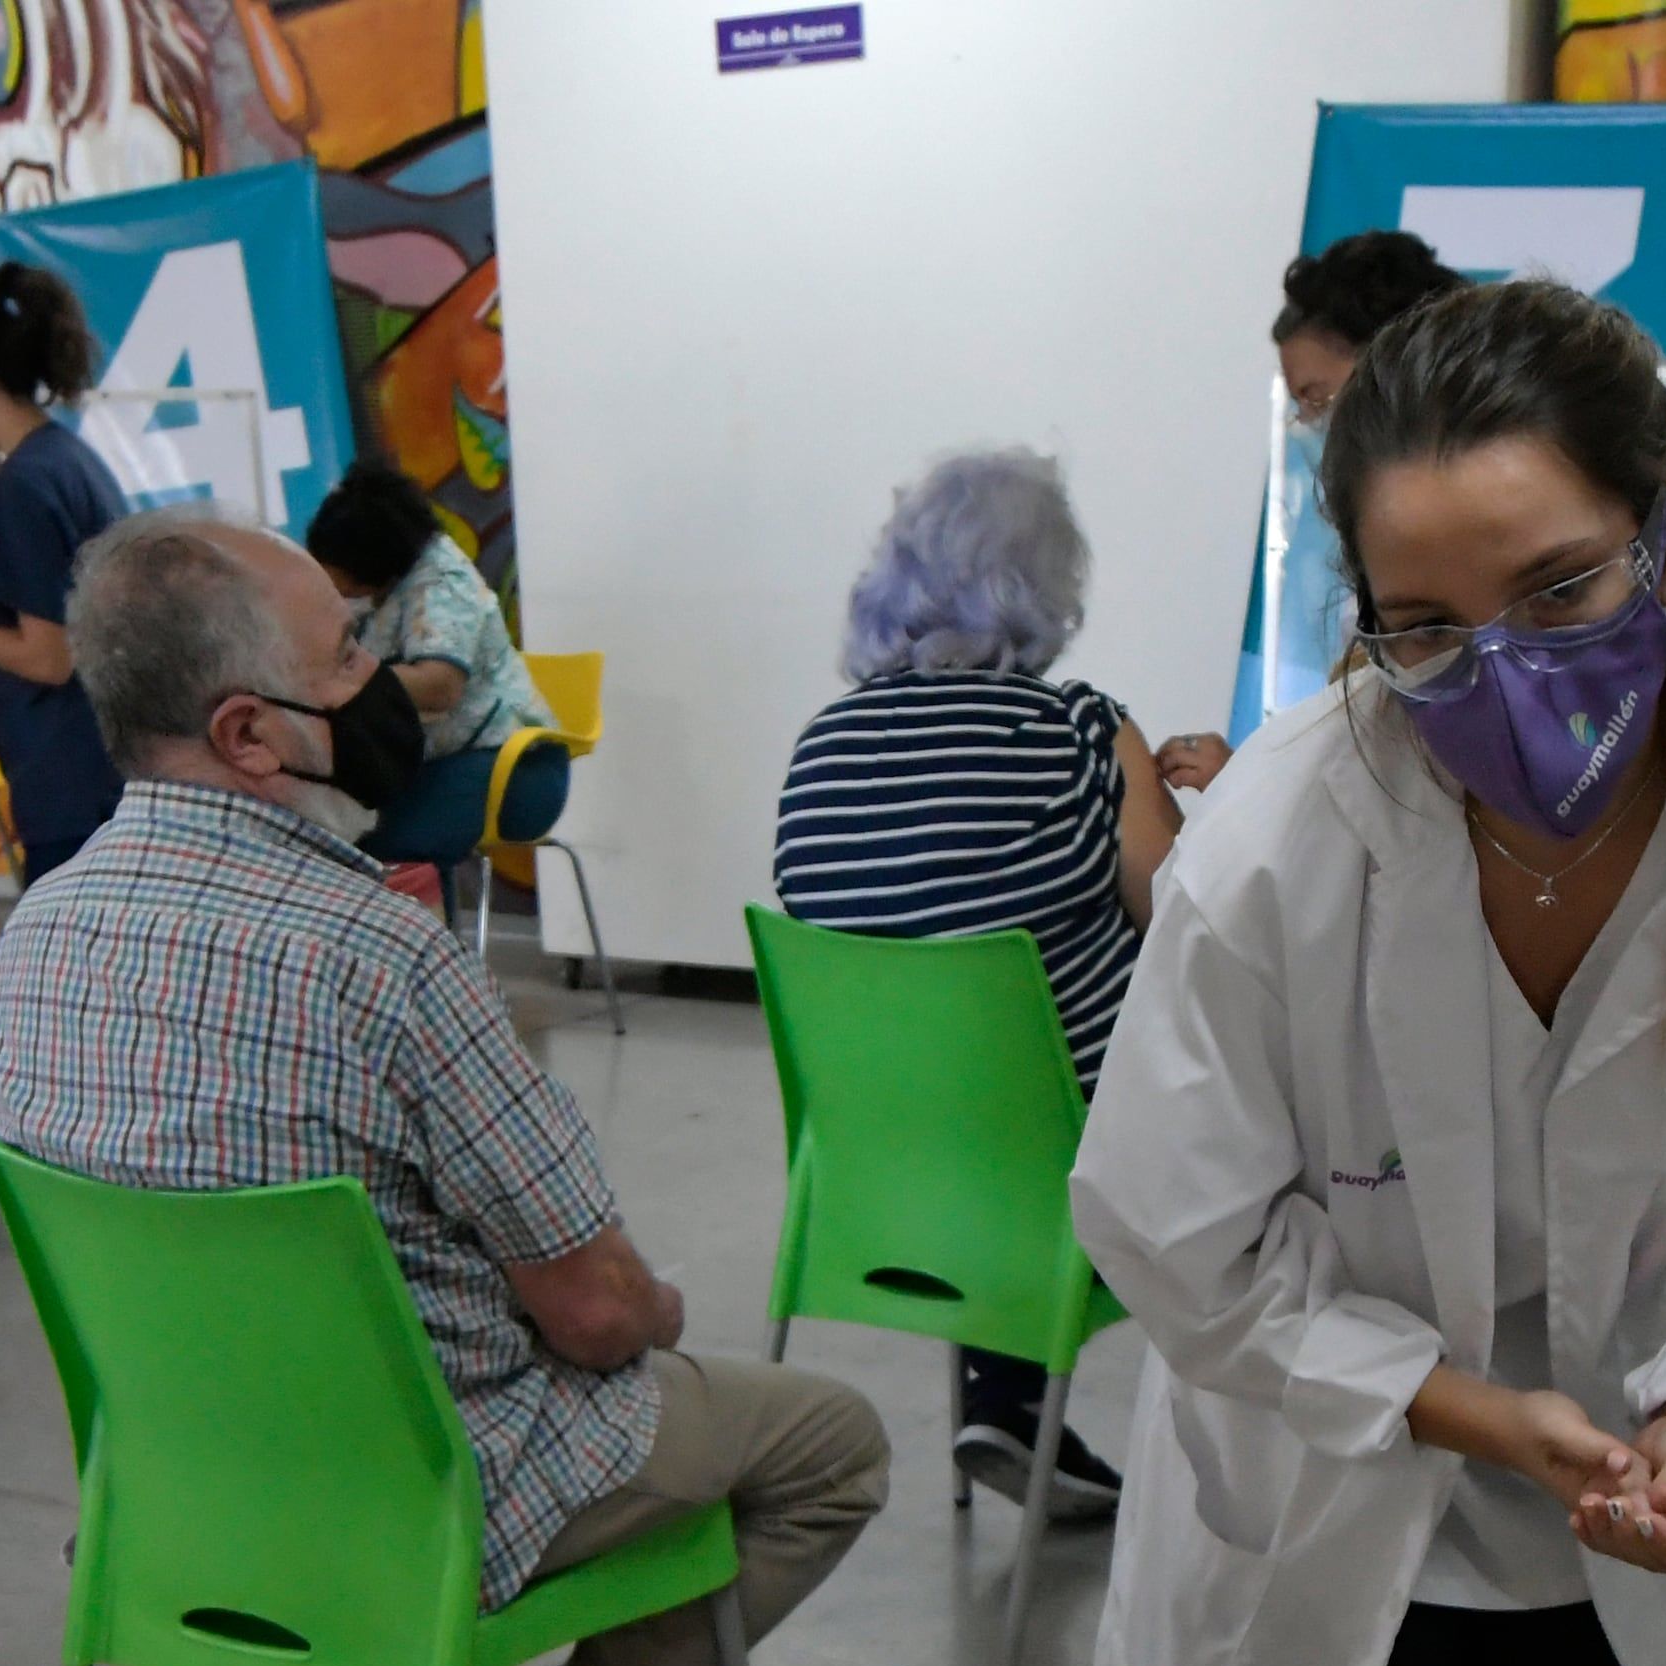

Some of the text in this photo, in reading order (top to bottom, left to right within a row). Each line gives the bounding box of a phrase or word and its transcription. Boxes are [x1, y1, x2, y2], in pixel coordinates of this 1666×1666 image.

[77, 240, 309, 527] 4
[1556, 689, 1639, 820] guaymallén
[1330, 1168, 1407, 1191] guayma
